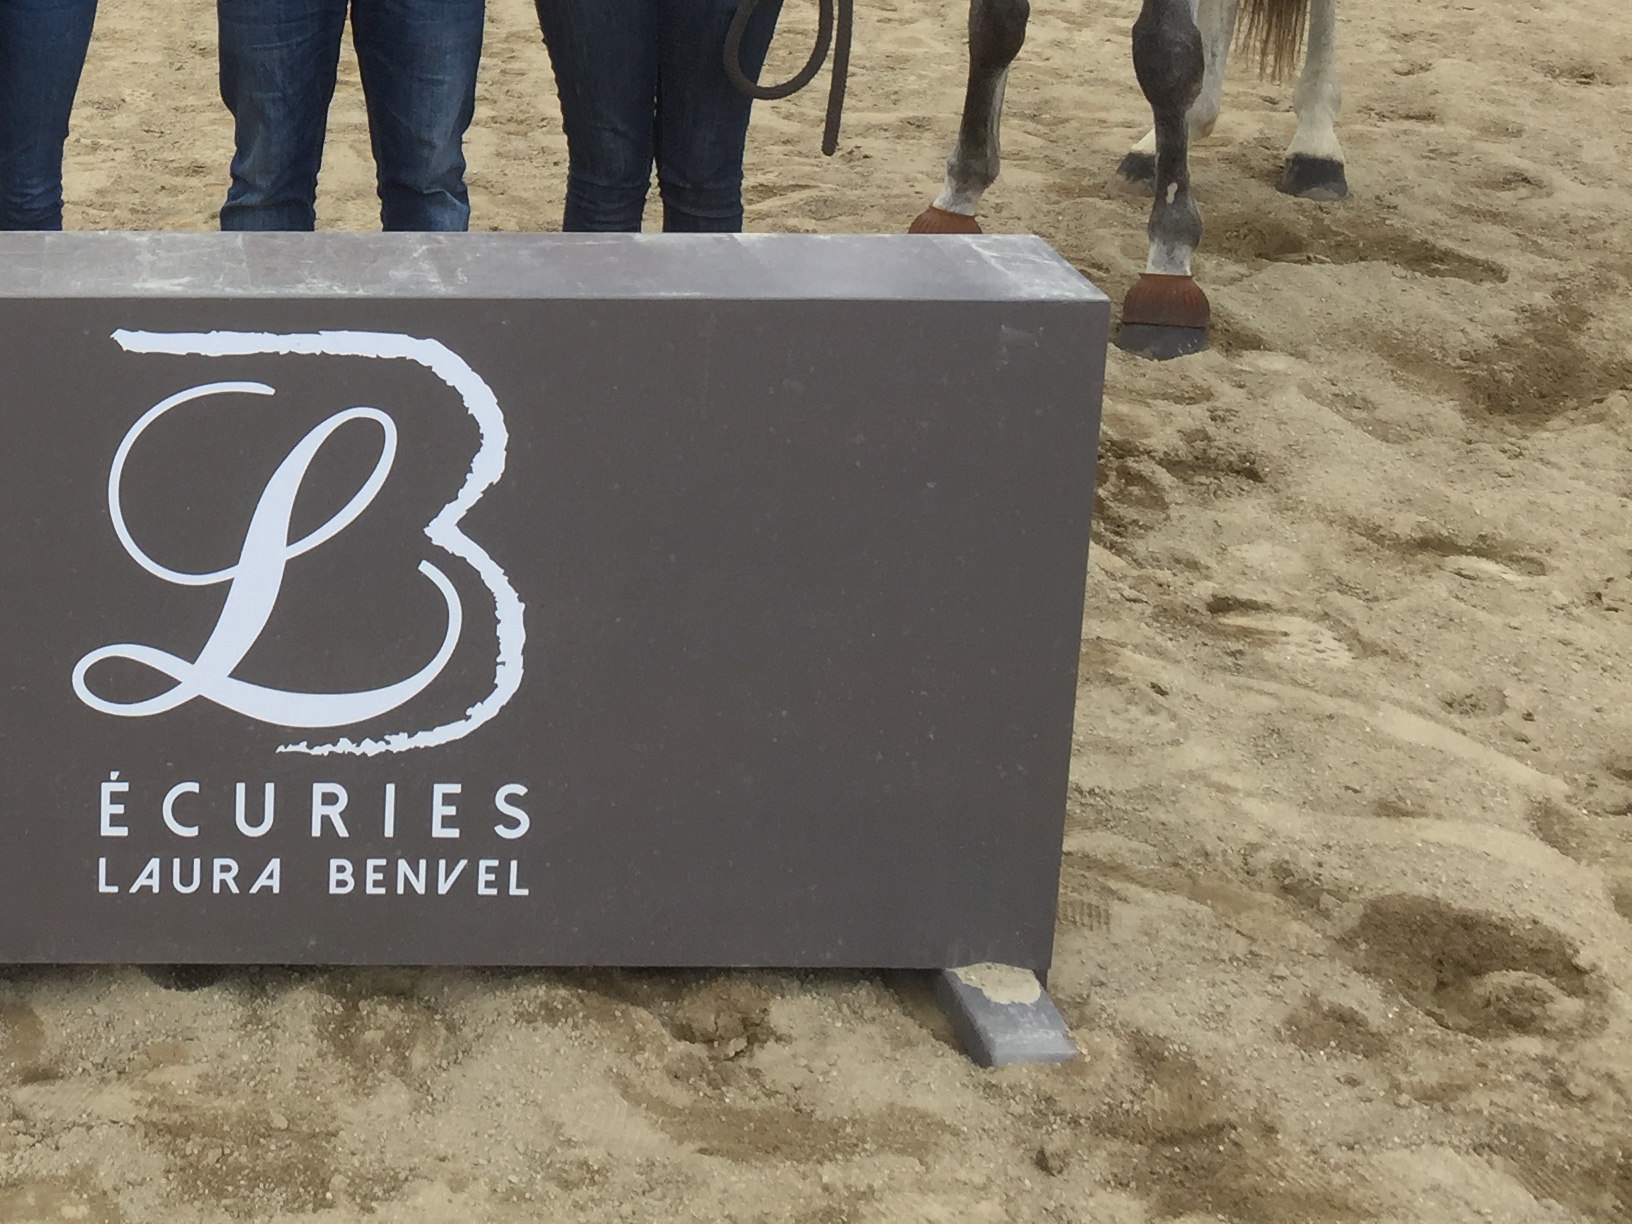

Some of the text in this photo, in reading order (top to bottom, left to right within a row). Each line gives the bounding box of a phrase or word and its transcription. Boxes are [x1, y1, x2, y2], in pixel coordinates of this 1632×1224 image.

[98, 771, 531, 840] ÉCURIES
[98, 857, 530, 896] LAURA BENVEL
